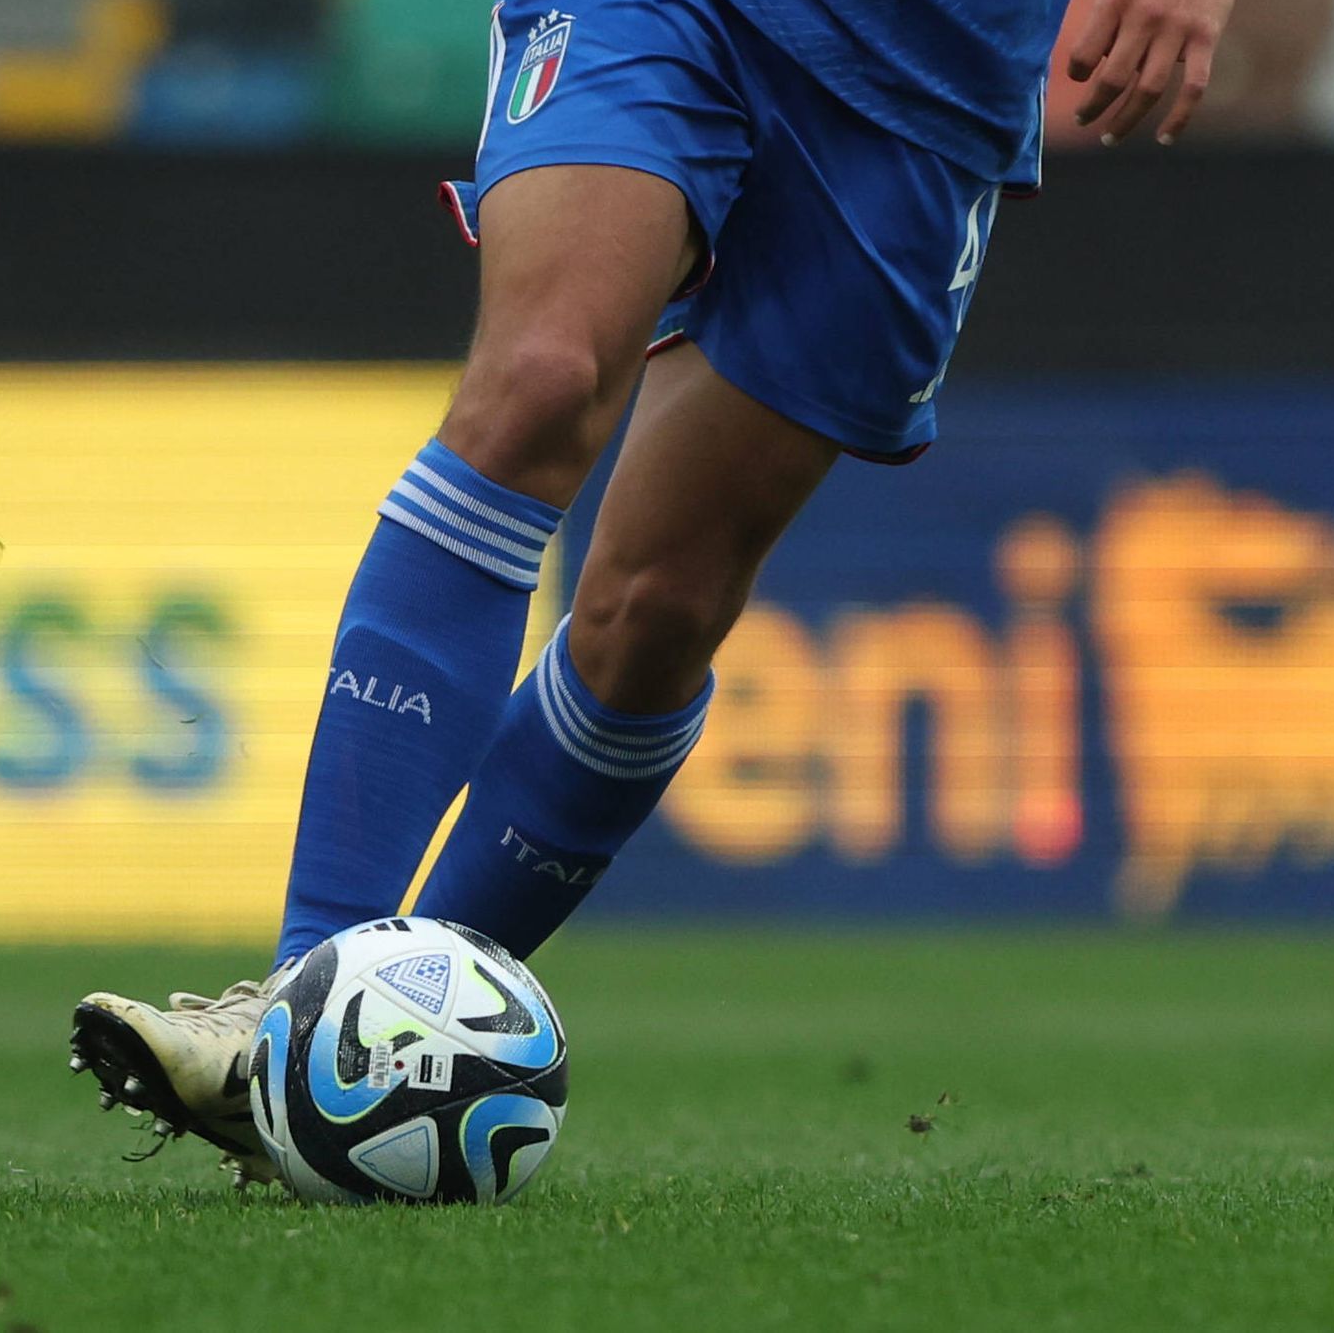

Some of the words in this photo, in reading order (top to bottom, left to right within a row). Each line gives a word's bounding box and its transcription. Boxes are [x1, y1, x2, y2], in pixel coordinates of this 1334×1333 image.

[524, 30, 564, 67] ITALIA
[329, 667, 432, 725] ALIA
[499, 825, 603, 886] ITAL
